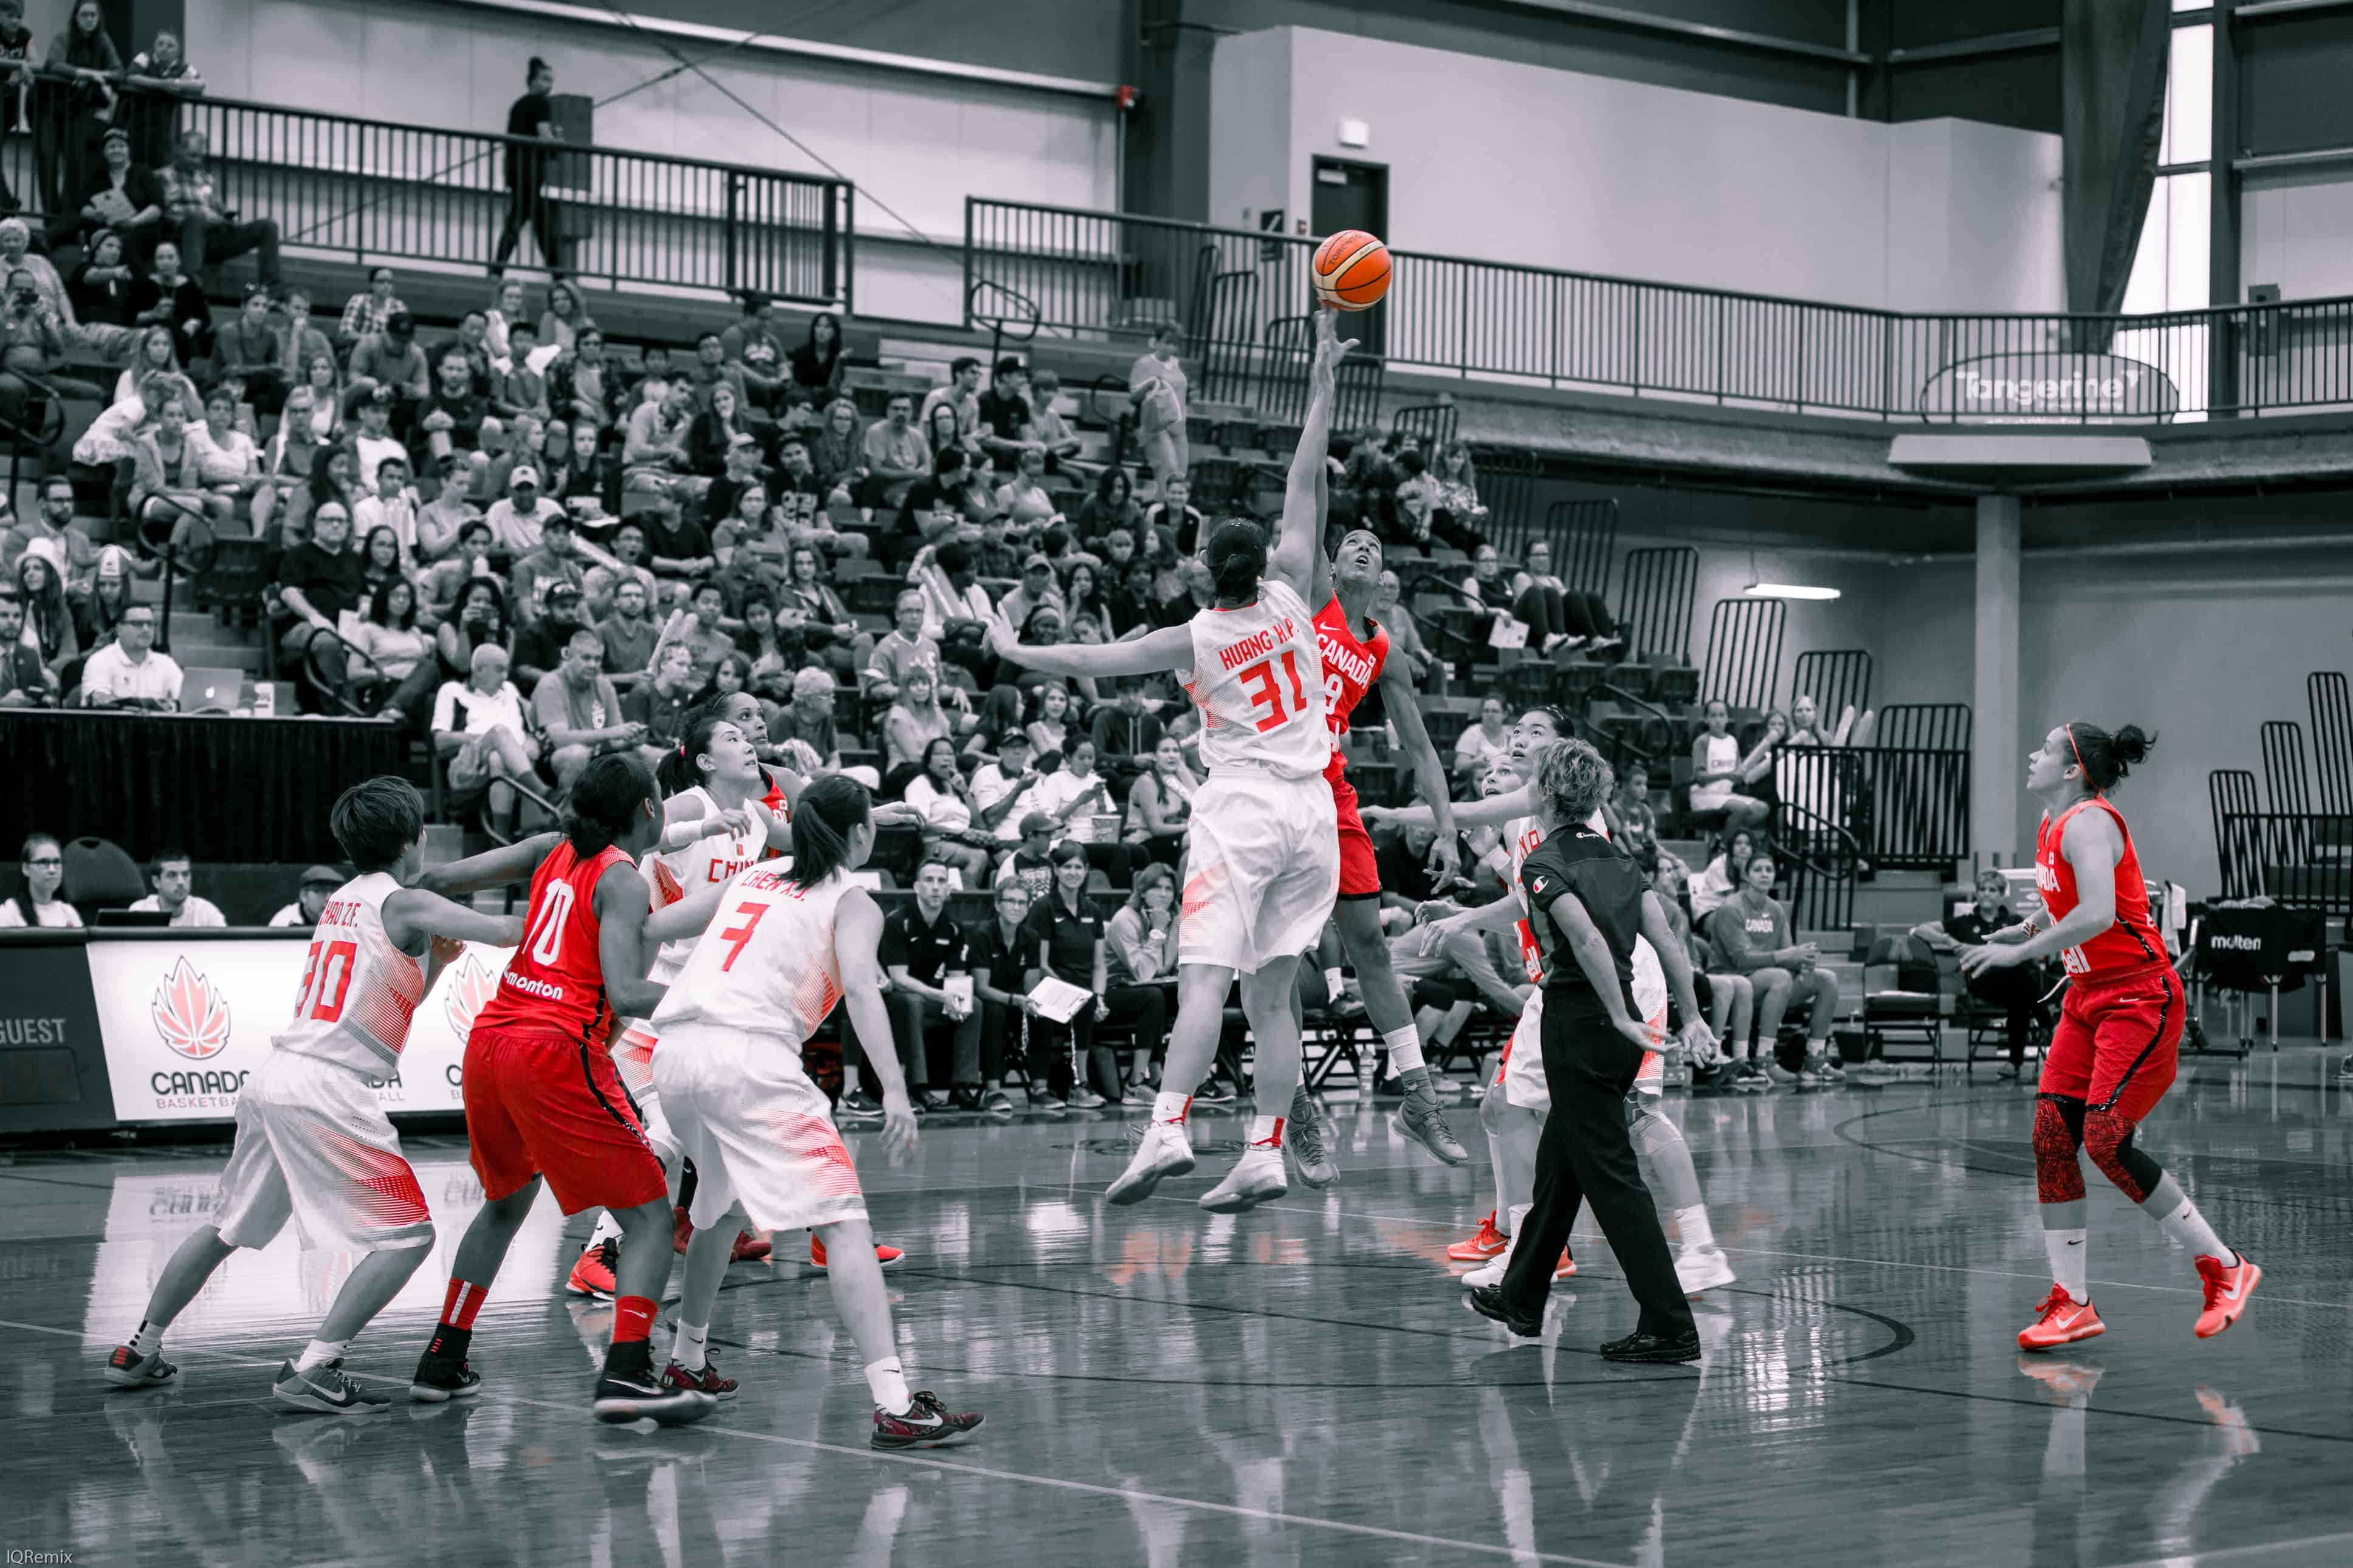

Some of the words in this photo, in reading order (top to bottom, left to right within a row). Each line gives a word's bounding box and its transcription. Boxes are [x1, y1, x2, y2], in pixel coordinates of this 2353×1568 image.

[1955, 371, 2124, 405] Tangerine
[1219, 629, 1274, 671] HUANG
[1273, 617, 1300, 644] H.P.
[1317, 633, 1372, 690] CANADA
[1238, 649, 1307, 733] 31
[1324, 673, 1344, 715] 9
[521, 878, 575, 967] 10
[720, 901, 771, 972] 7
[2210, 934, 2261, 951] molten
[503, 963, 563, 1000] monton
